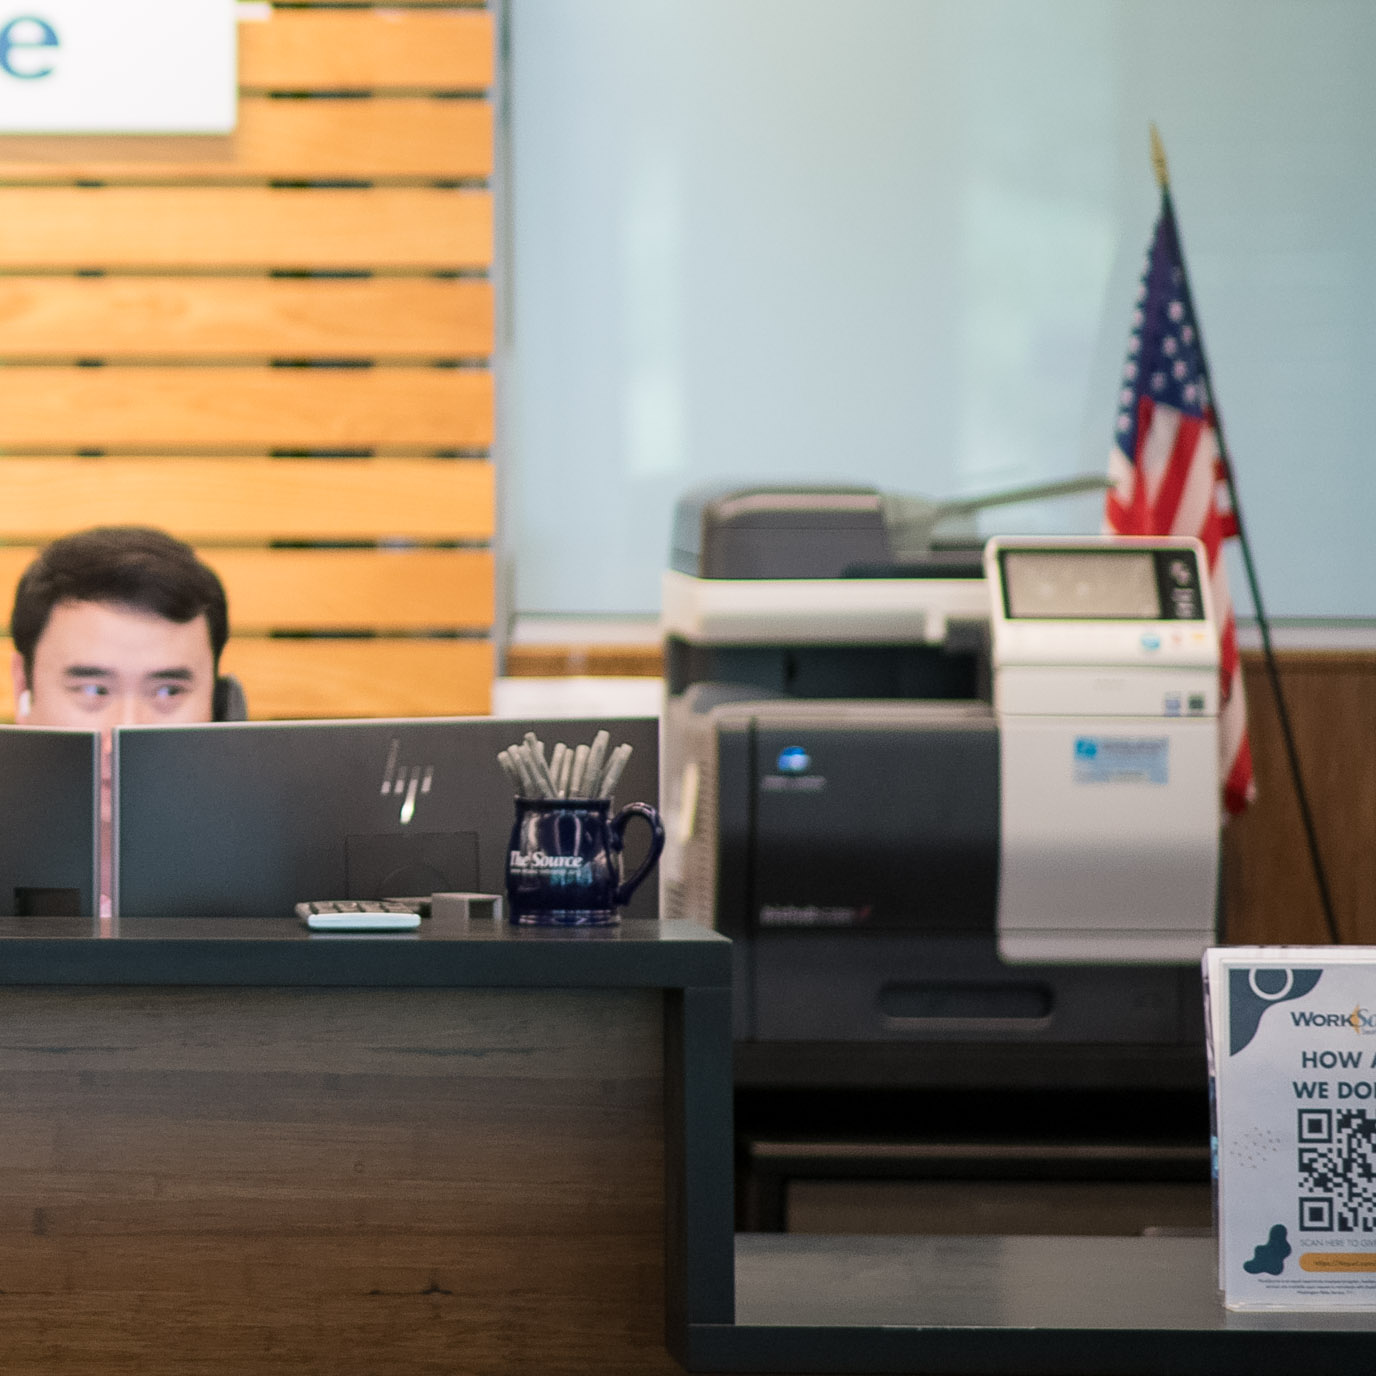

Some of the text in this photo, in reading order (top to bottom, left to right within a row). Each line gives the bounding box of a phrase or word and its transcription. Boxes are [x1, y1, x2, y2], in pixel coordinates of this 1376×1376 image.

[380, 738, 435, 824] hp
[532, 852, 584, 868] Source
[1301, 1050, 1363, 1069] HOW
[1292, 1081, 1376, 1100] WE DO
